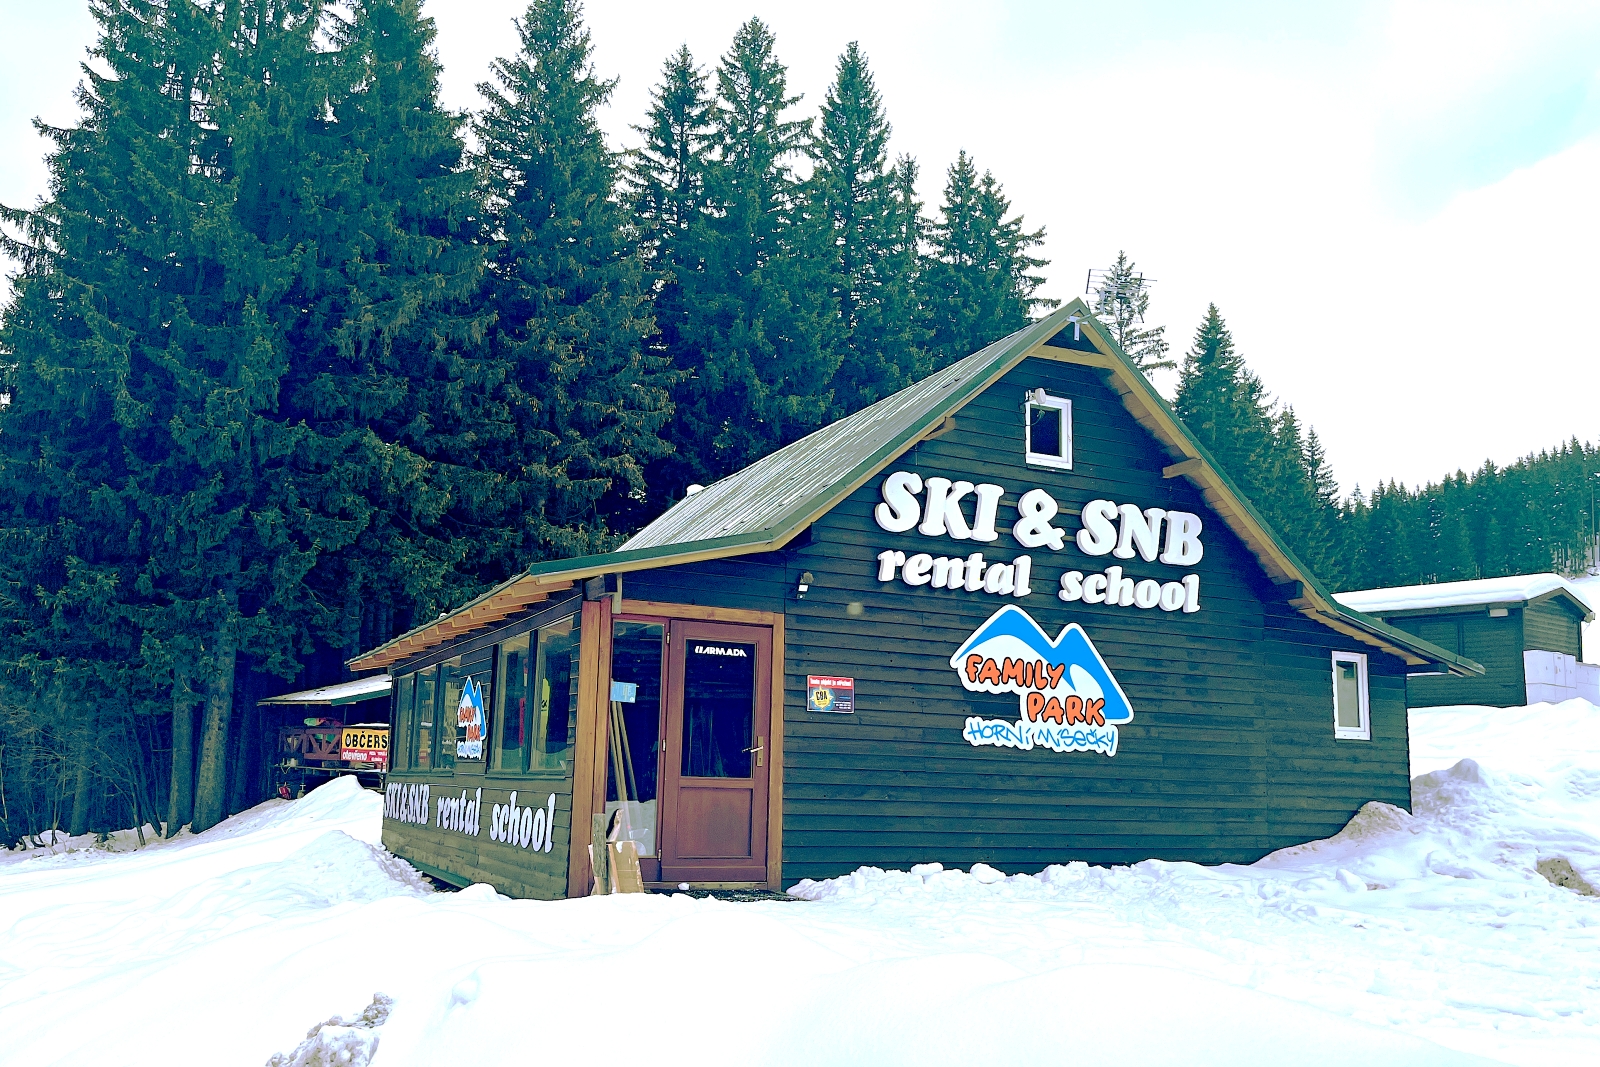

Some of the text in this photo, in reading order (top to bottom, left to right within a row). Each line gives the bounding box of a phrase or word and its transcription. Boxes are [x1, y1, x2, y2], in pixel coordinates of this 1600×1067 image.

[875, 471, 1203, 566] SKI & SNB
[877, 550, 1200, 613] rental school
[702, 646, 747, 657] ARMADA
[965, 654, 1065, 690] FAMILY
[1027, 691, 1106, 727] PARK
[436, 787, 482, 836] rental
[490, 790, 556, 853] school
